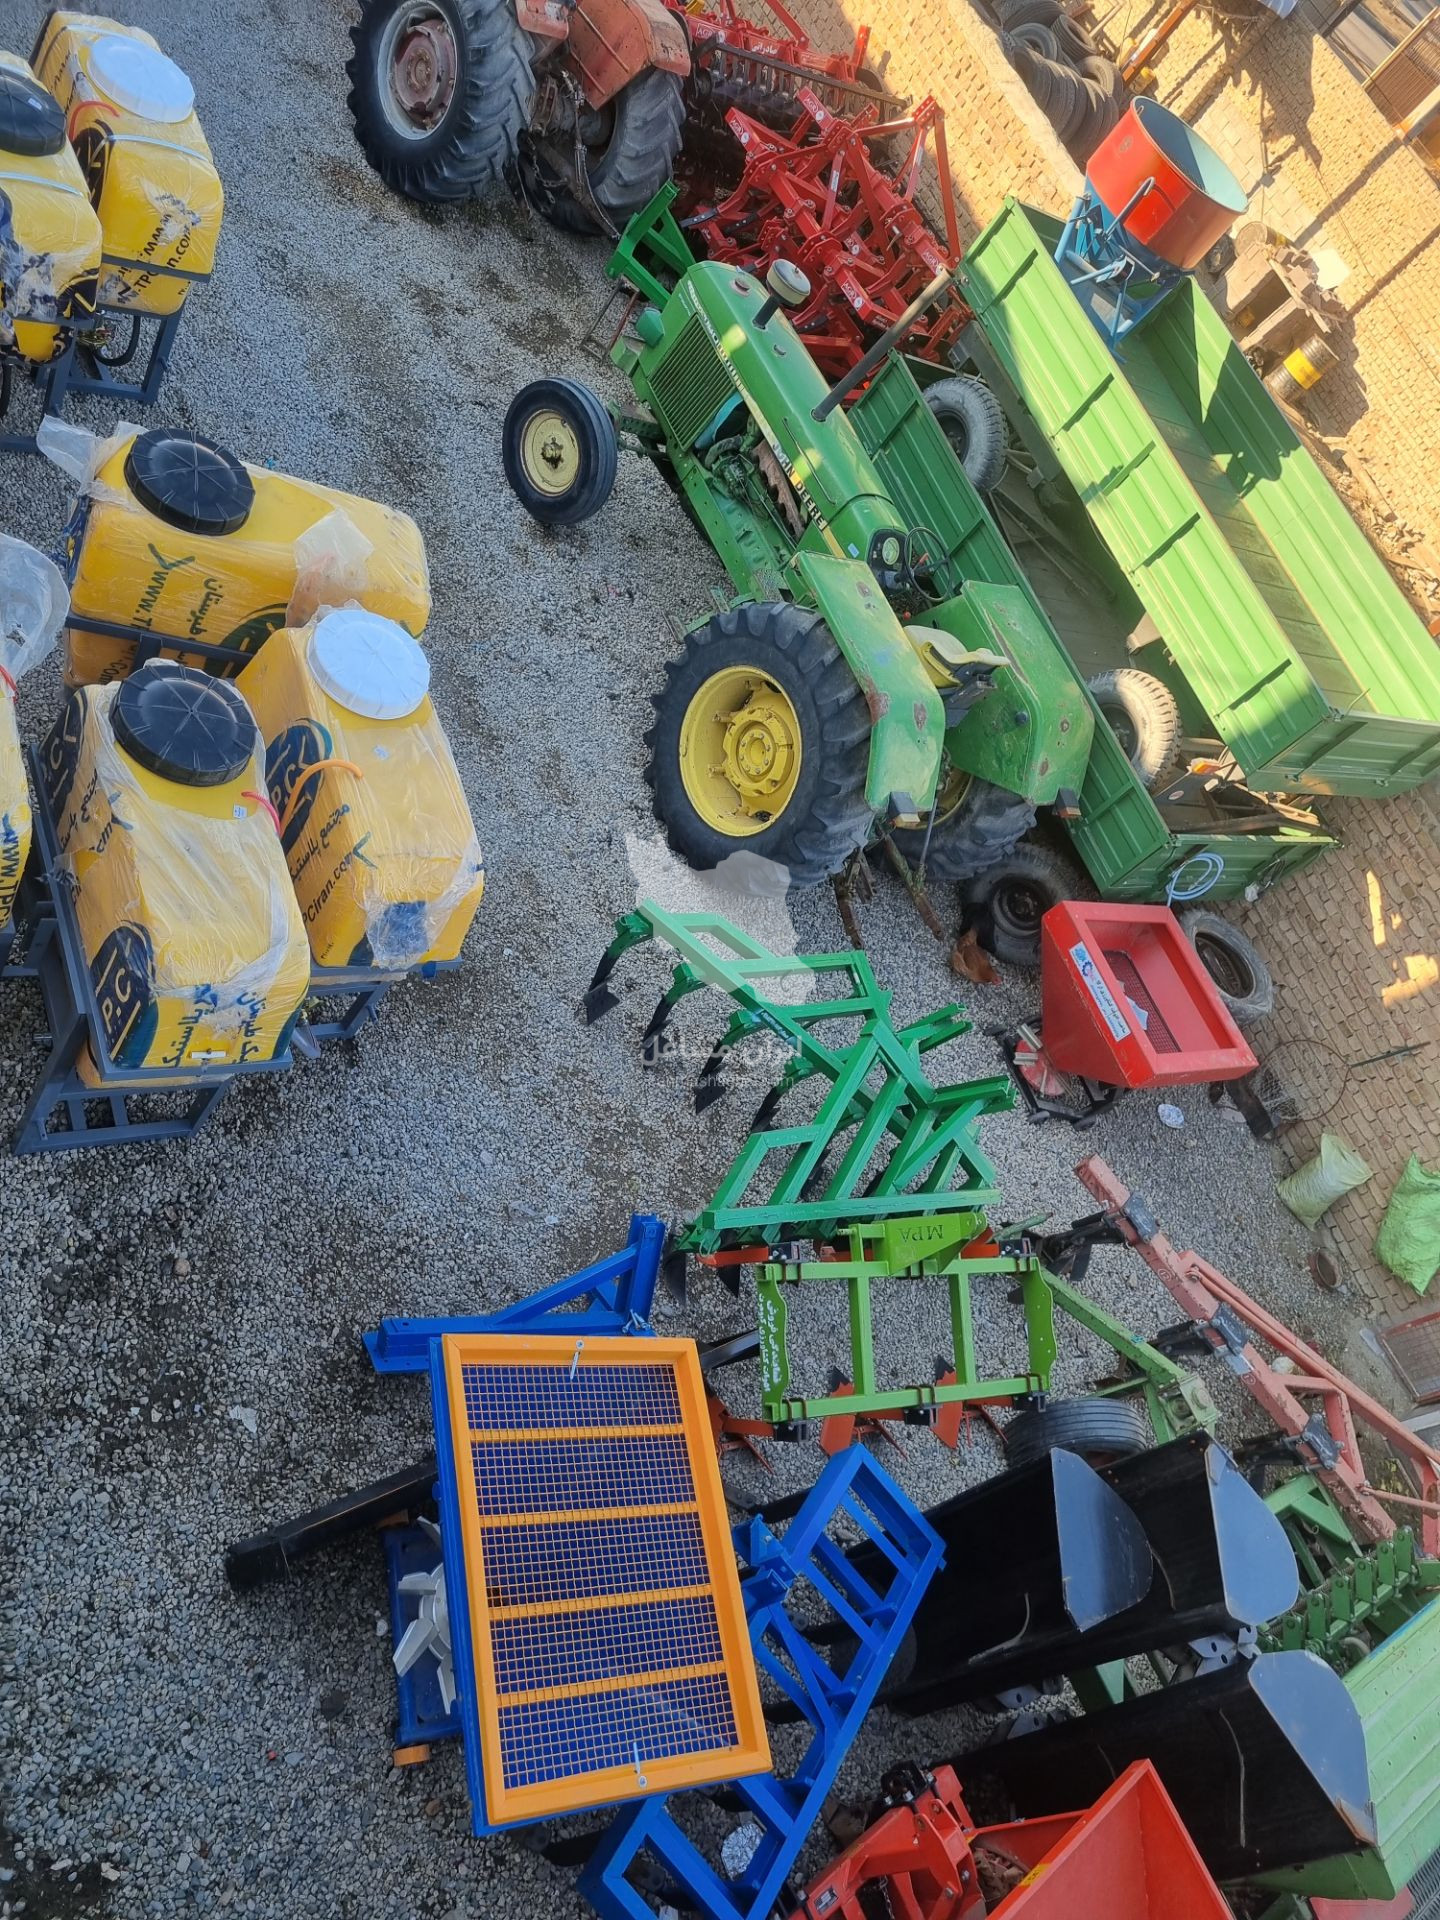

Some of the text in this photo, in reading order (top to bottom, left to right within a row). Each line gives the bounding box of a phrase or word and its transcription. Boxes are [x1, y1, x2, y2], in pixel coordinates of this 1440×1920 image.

[773, 443, 827, 525] JOHN DEERE
[900, 1224, 943, 1243] MPA
